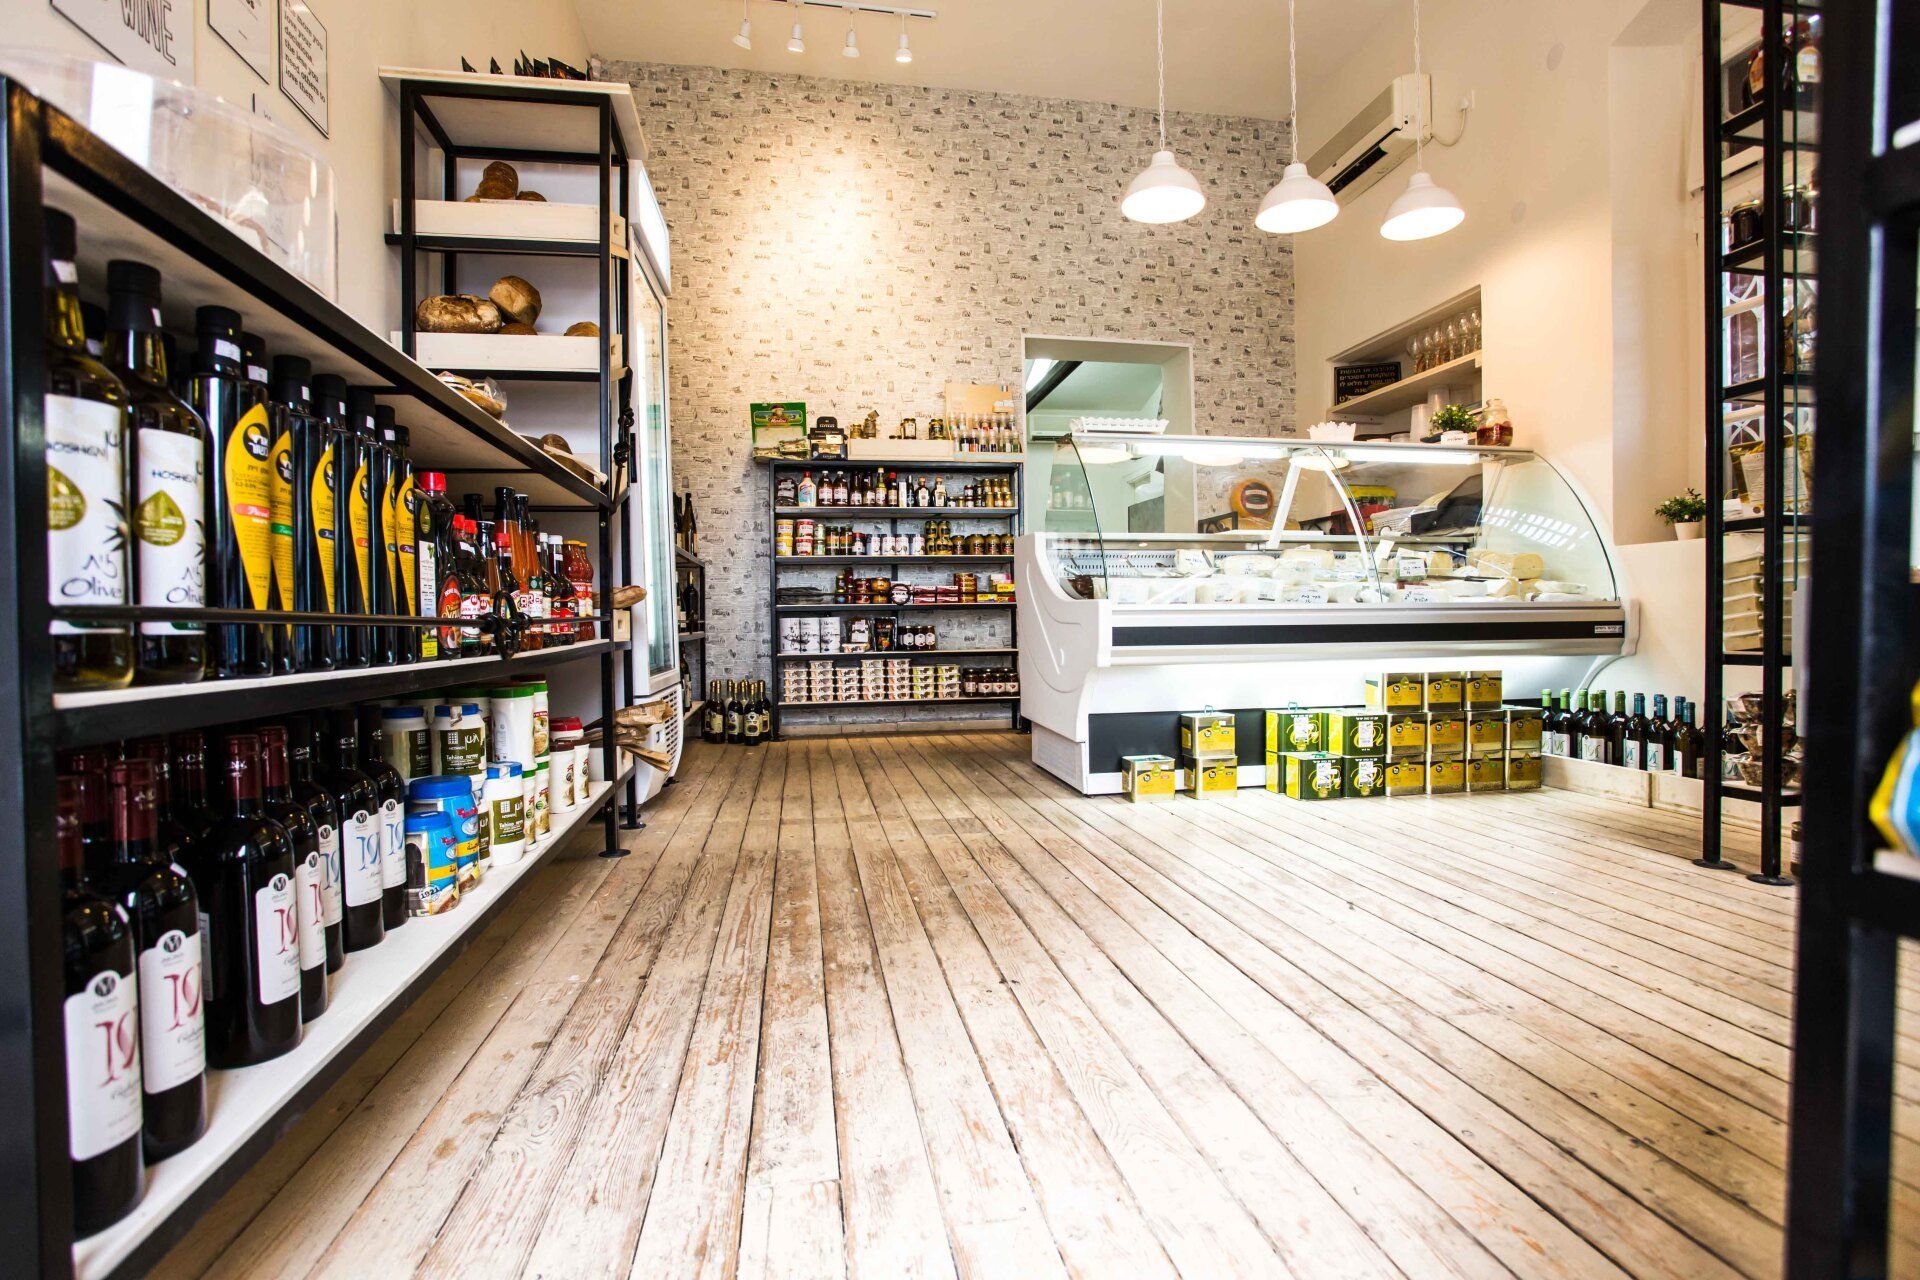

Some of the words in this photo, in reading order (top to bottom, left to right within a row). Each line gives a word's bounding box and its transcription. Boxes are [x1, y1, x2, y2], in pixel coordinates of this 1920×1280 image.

[298, 29, 312, 49] your
[313, 34, 323, 51] you
[306, 66, 319, 83] you
[61, 576, 122, 599] Olive
[420, 885, 440, 899] 1921
